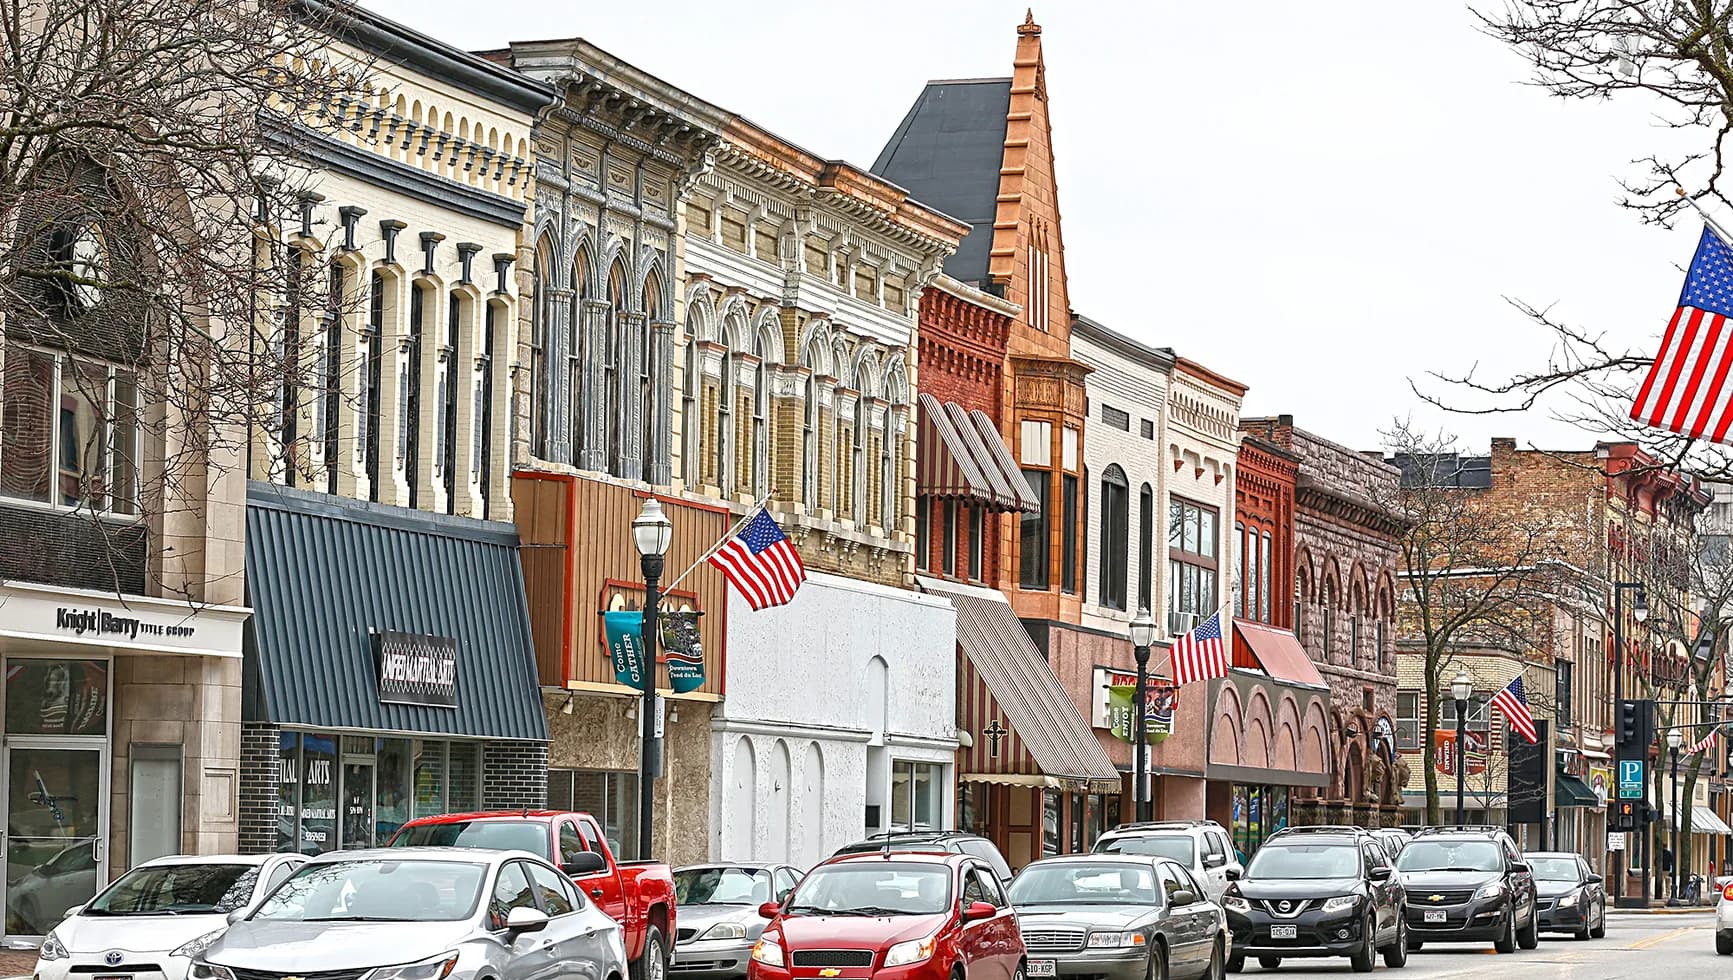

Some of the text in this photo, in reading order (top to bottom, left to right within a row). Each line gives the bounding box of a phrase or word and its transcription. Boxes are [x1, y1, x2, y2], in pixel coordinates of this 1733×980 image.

[140, 623, 163, 635] TITLE
[166, 625, 195, 637] GROUP
[406, 654, 437, 685] MARTIAL
[437, 659, 455, 686] ARTS
[614, 642, 625, 673] Come
[622, 632, 640, 682] GATHER
[1122, 706, 1130, 737] ENJOY
[307, 760, 330, 785] ARTS
[1624, 762, 1639, 781] P
